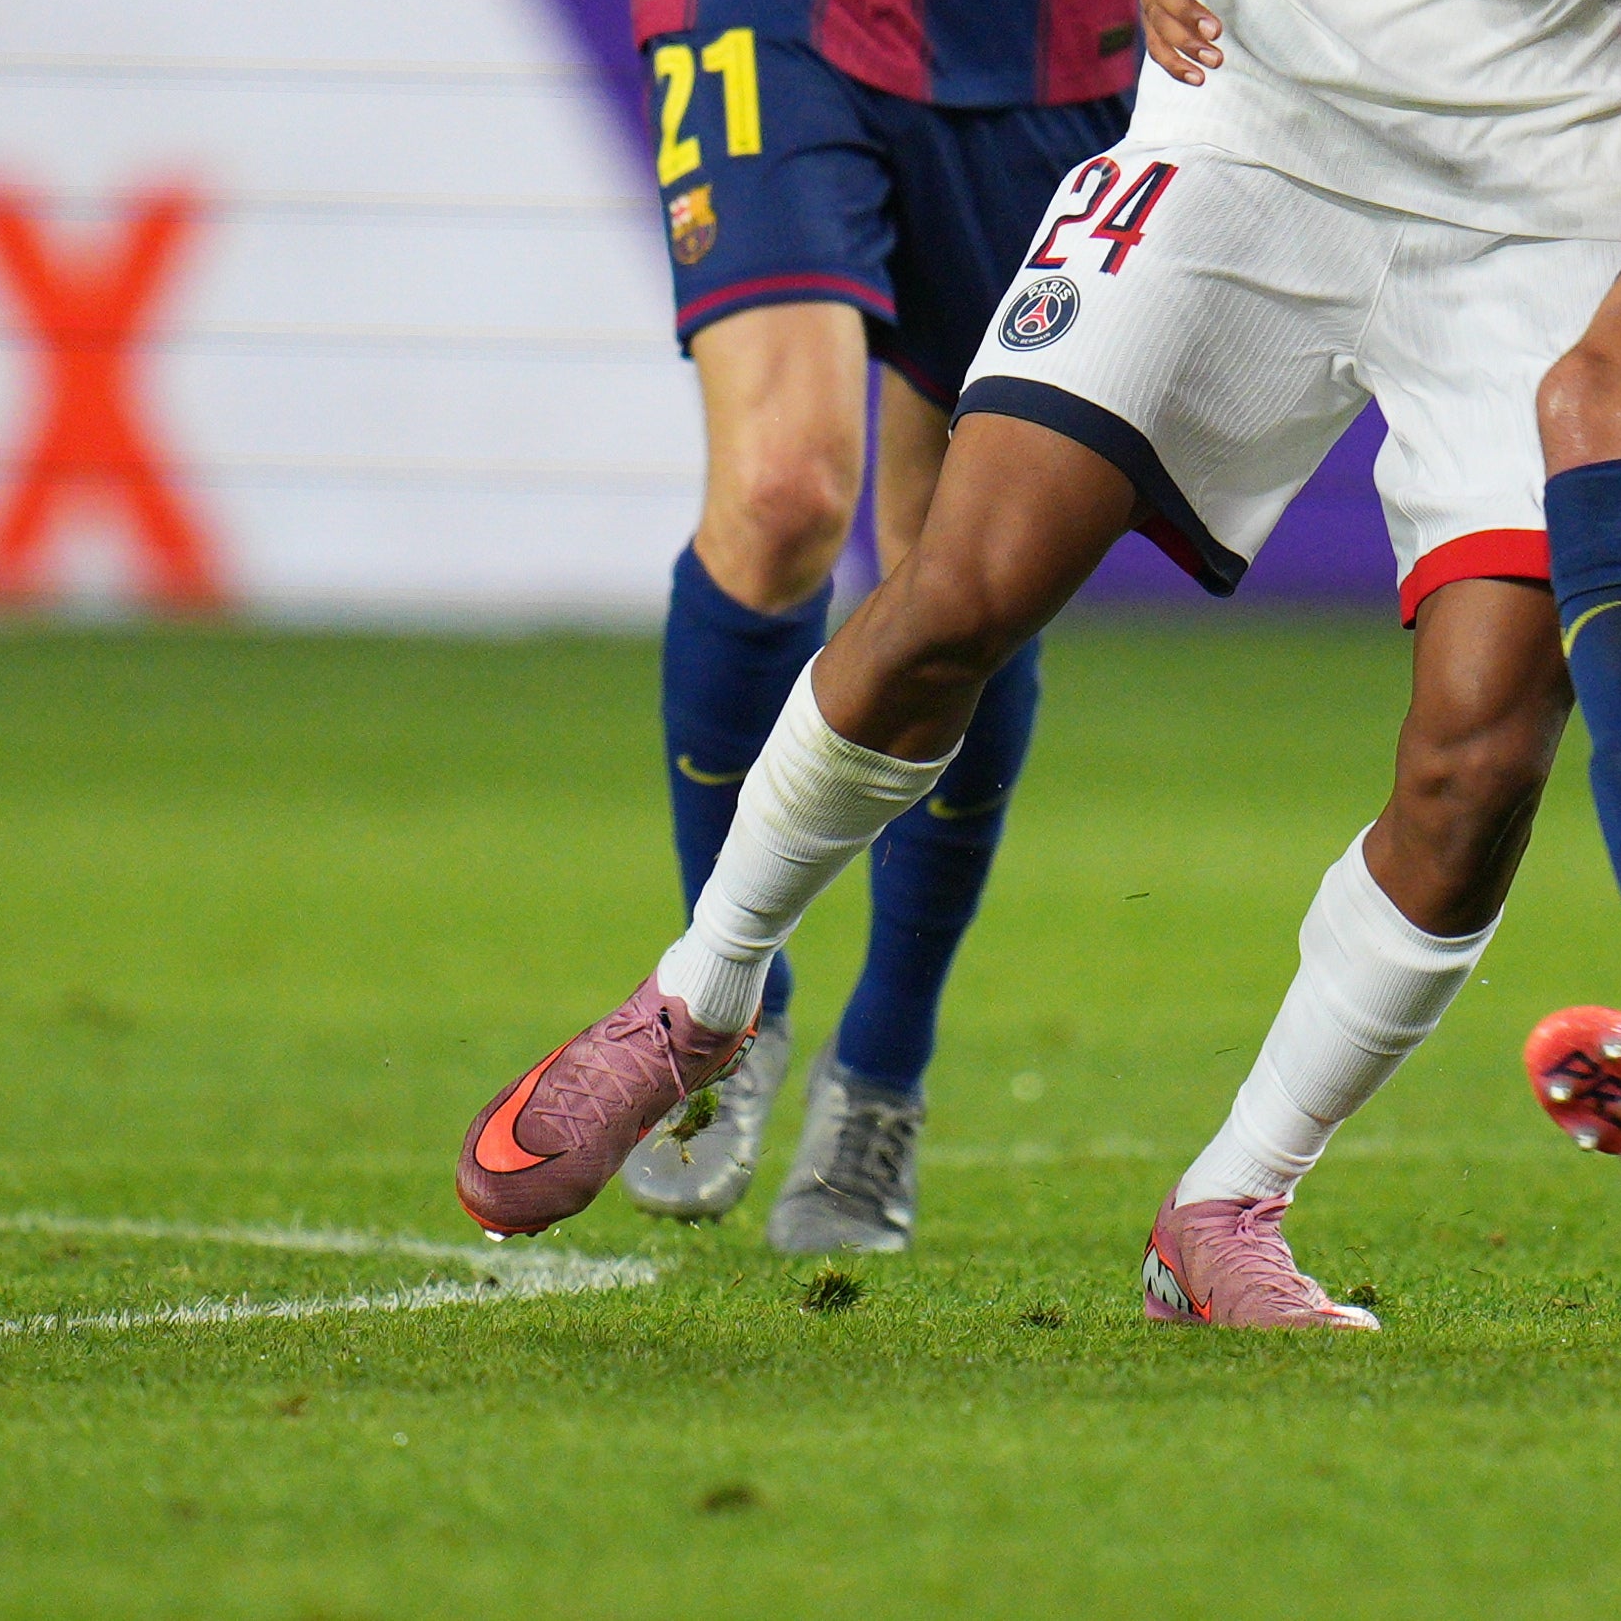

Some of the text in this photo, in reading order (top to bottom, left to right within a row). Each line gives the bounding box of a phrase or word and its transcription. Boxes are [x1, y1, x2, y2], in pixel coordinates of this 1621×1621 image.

[654, 27, 763, 187] 21
[1025, 156, 1179, 276] 24
[1027, 281, 1072, 302] PARIS
